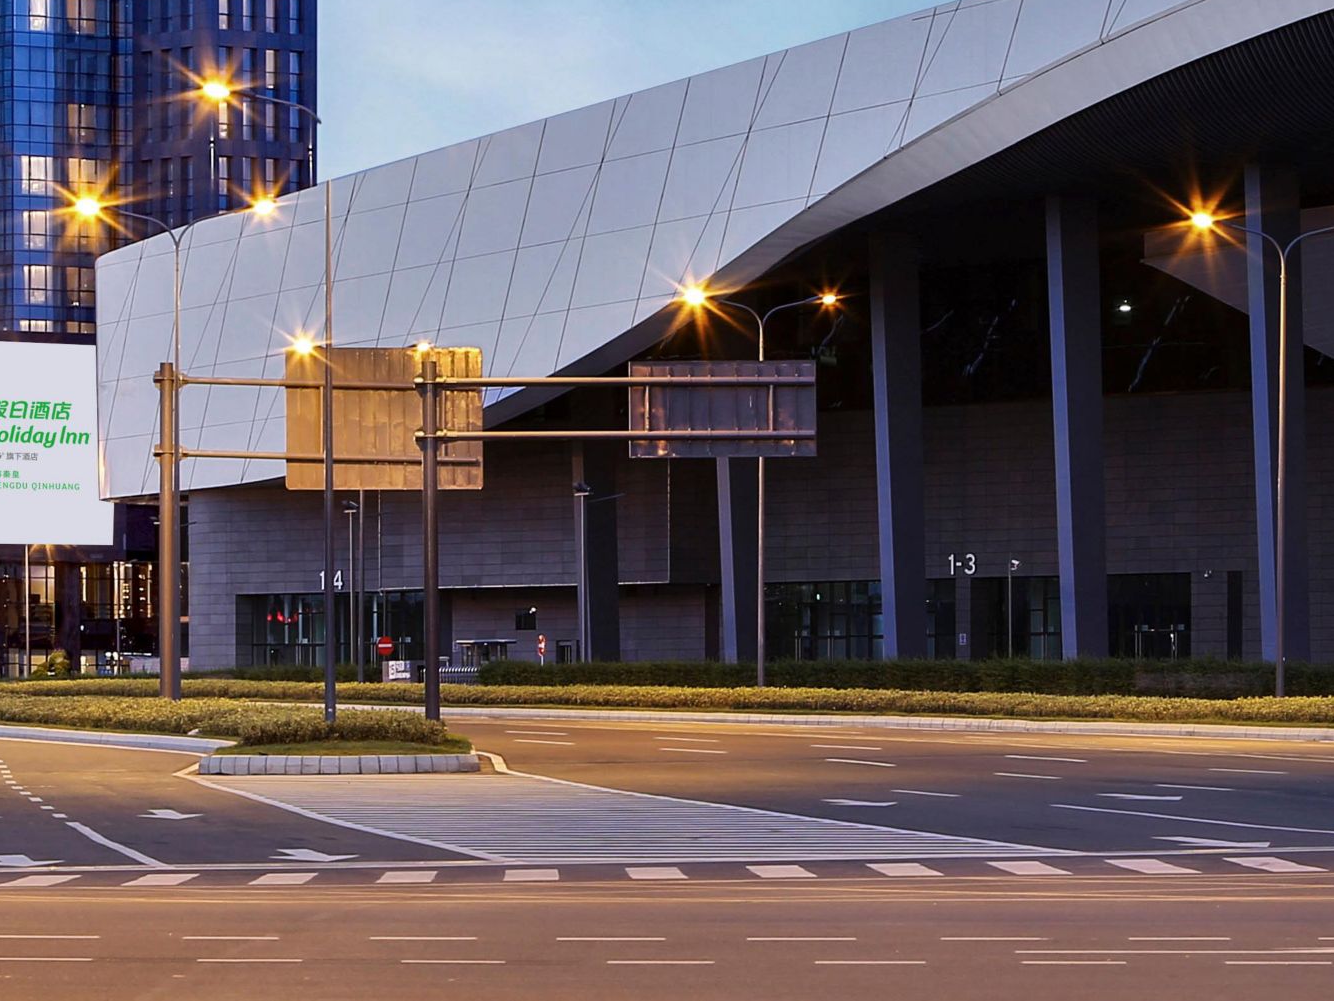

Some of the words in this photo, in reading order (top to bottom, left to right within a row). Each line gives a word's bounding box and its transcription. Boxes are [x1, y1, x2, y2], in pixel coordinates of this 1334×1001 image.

[59, 425, 90, 445] Inn
[6, 452, 38, 461] 旗下酒店
[31, 482, 80, 491] QINHUANG
[948, 554, 976, 575] 1-3
[319, 570, 343, 590] 14
